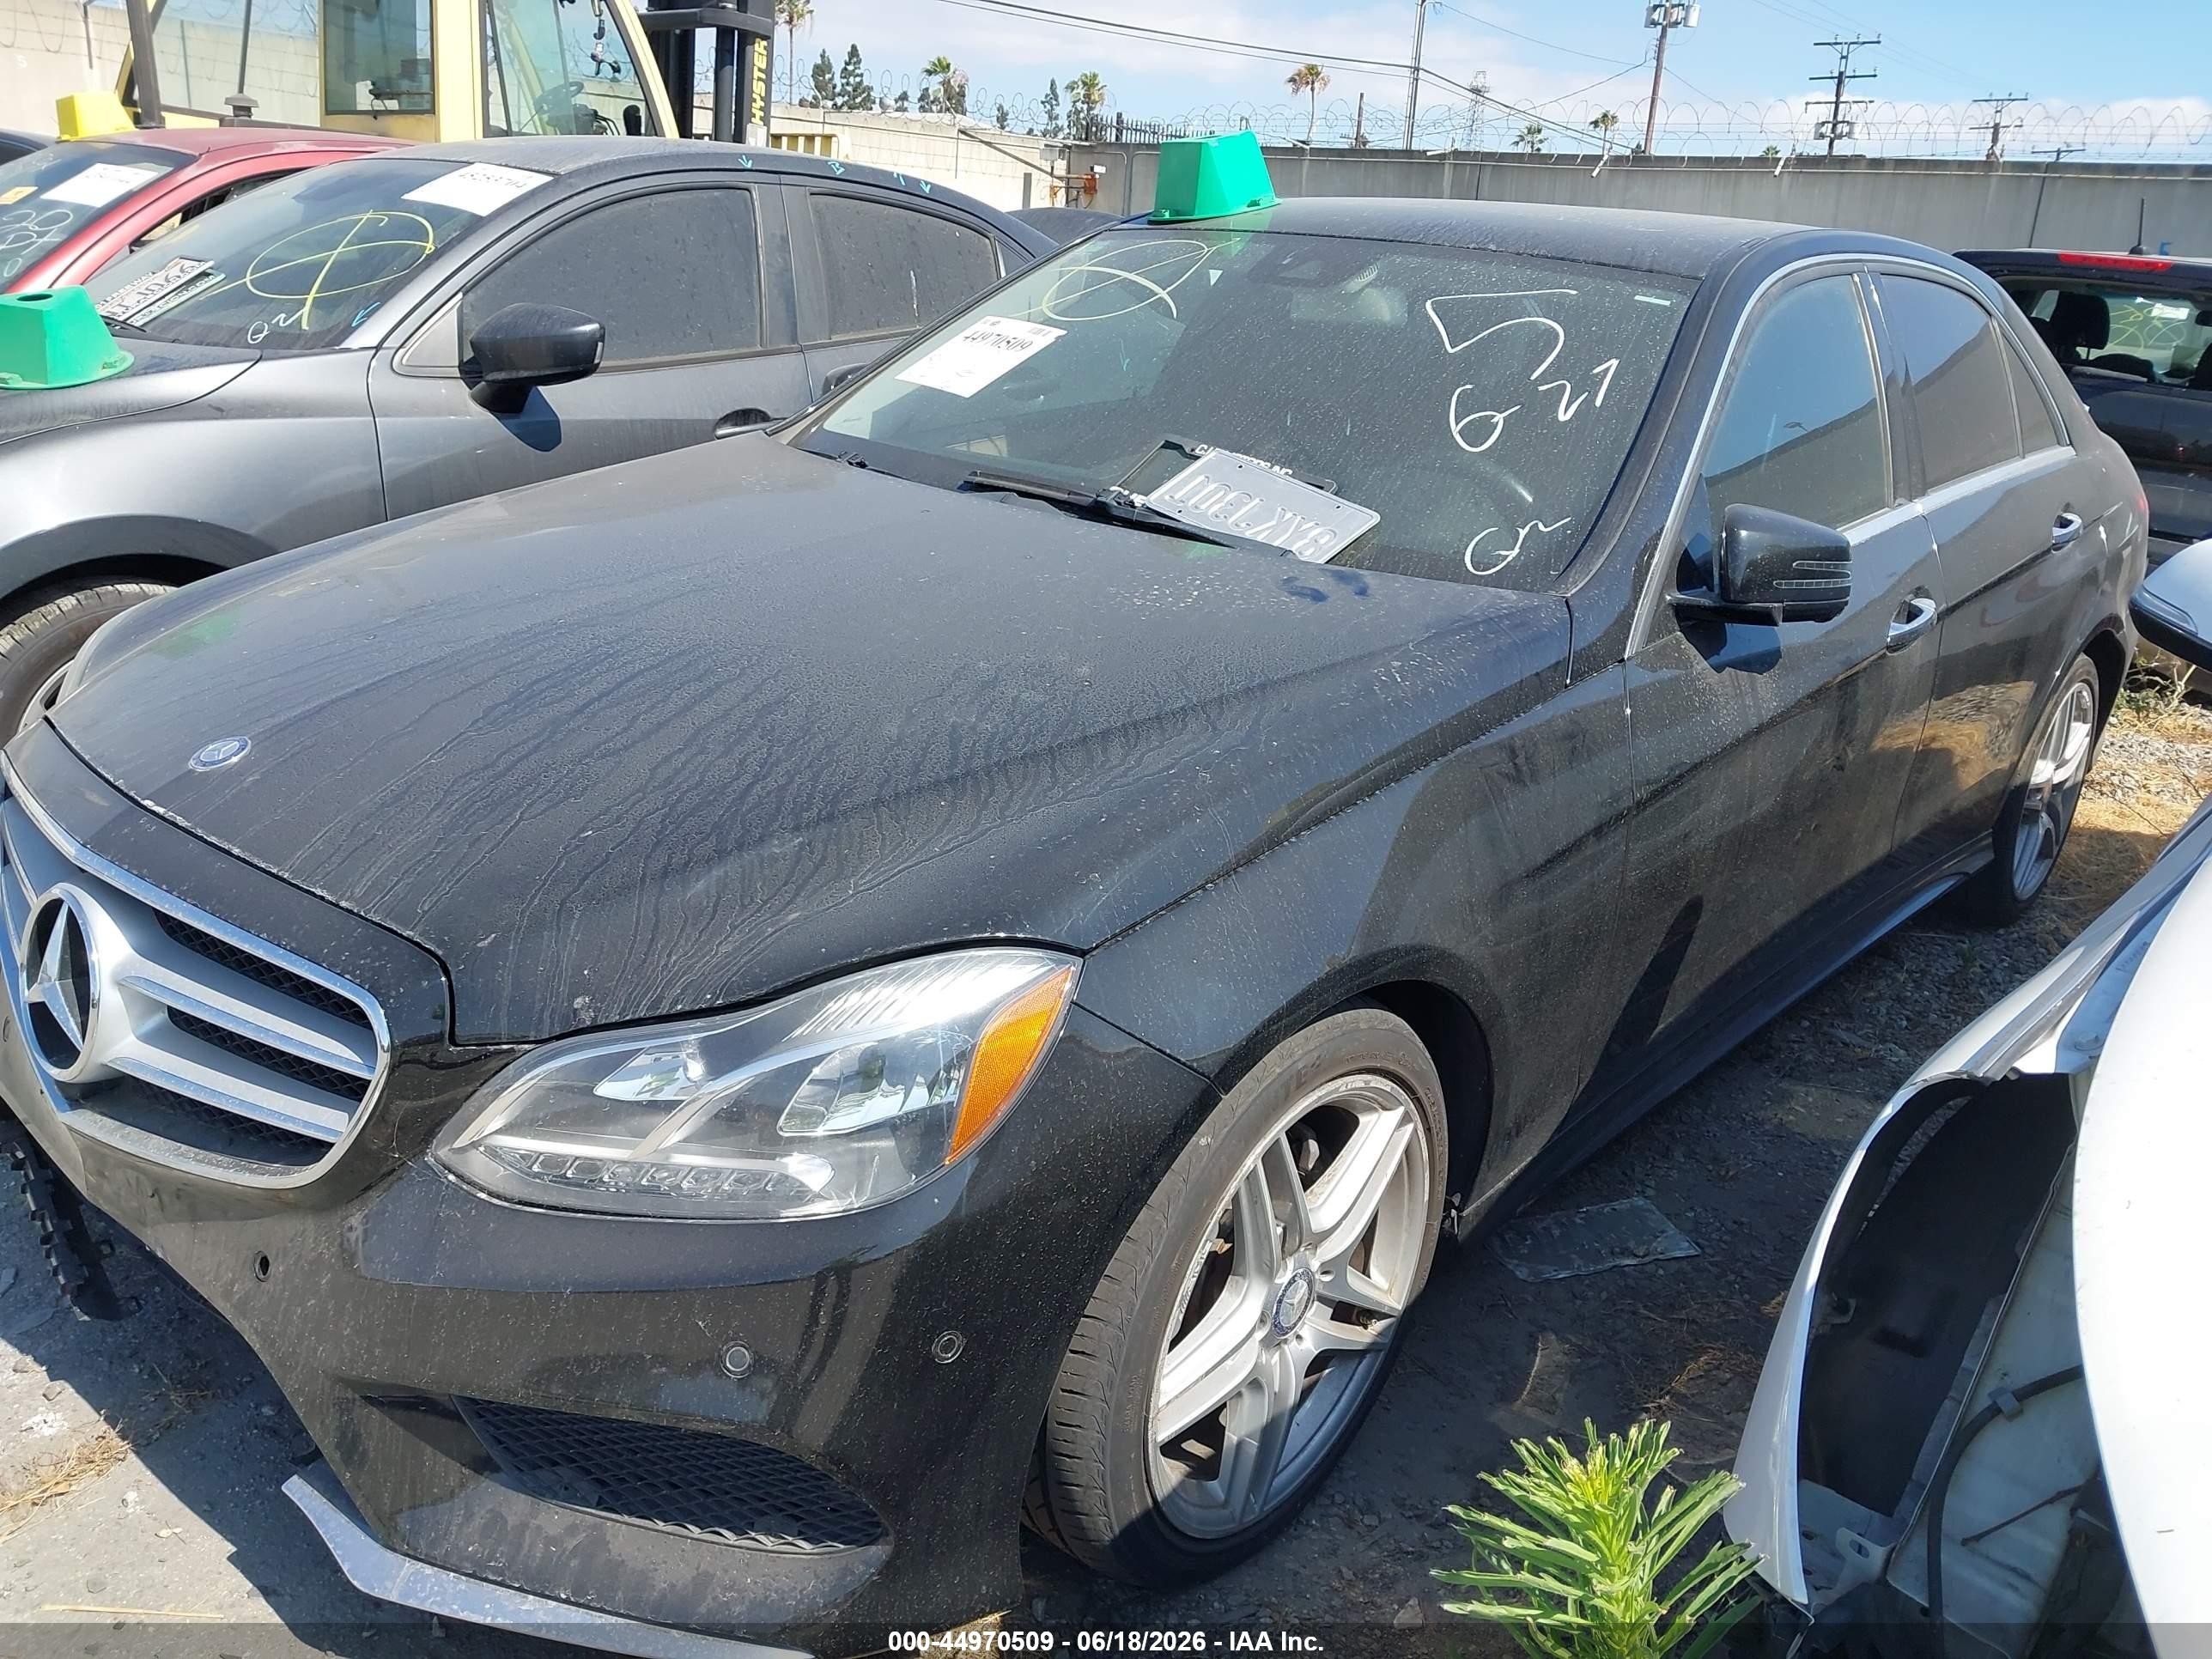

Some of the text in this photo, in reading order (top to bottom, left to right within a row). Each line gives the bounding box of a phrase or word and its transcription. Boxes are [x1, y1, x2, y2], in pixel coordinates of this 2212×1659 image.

[751, 37, 769, 125] HYSTER
[963, 330, 1034, 352] 44970509
[1425, 289, 1578, 381] 5
